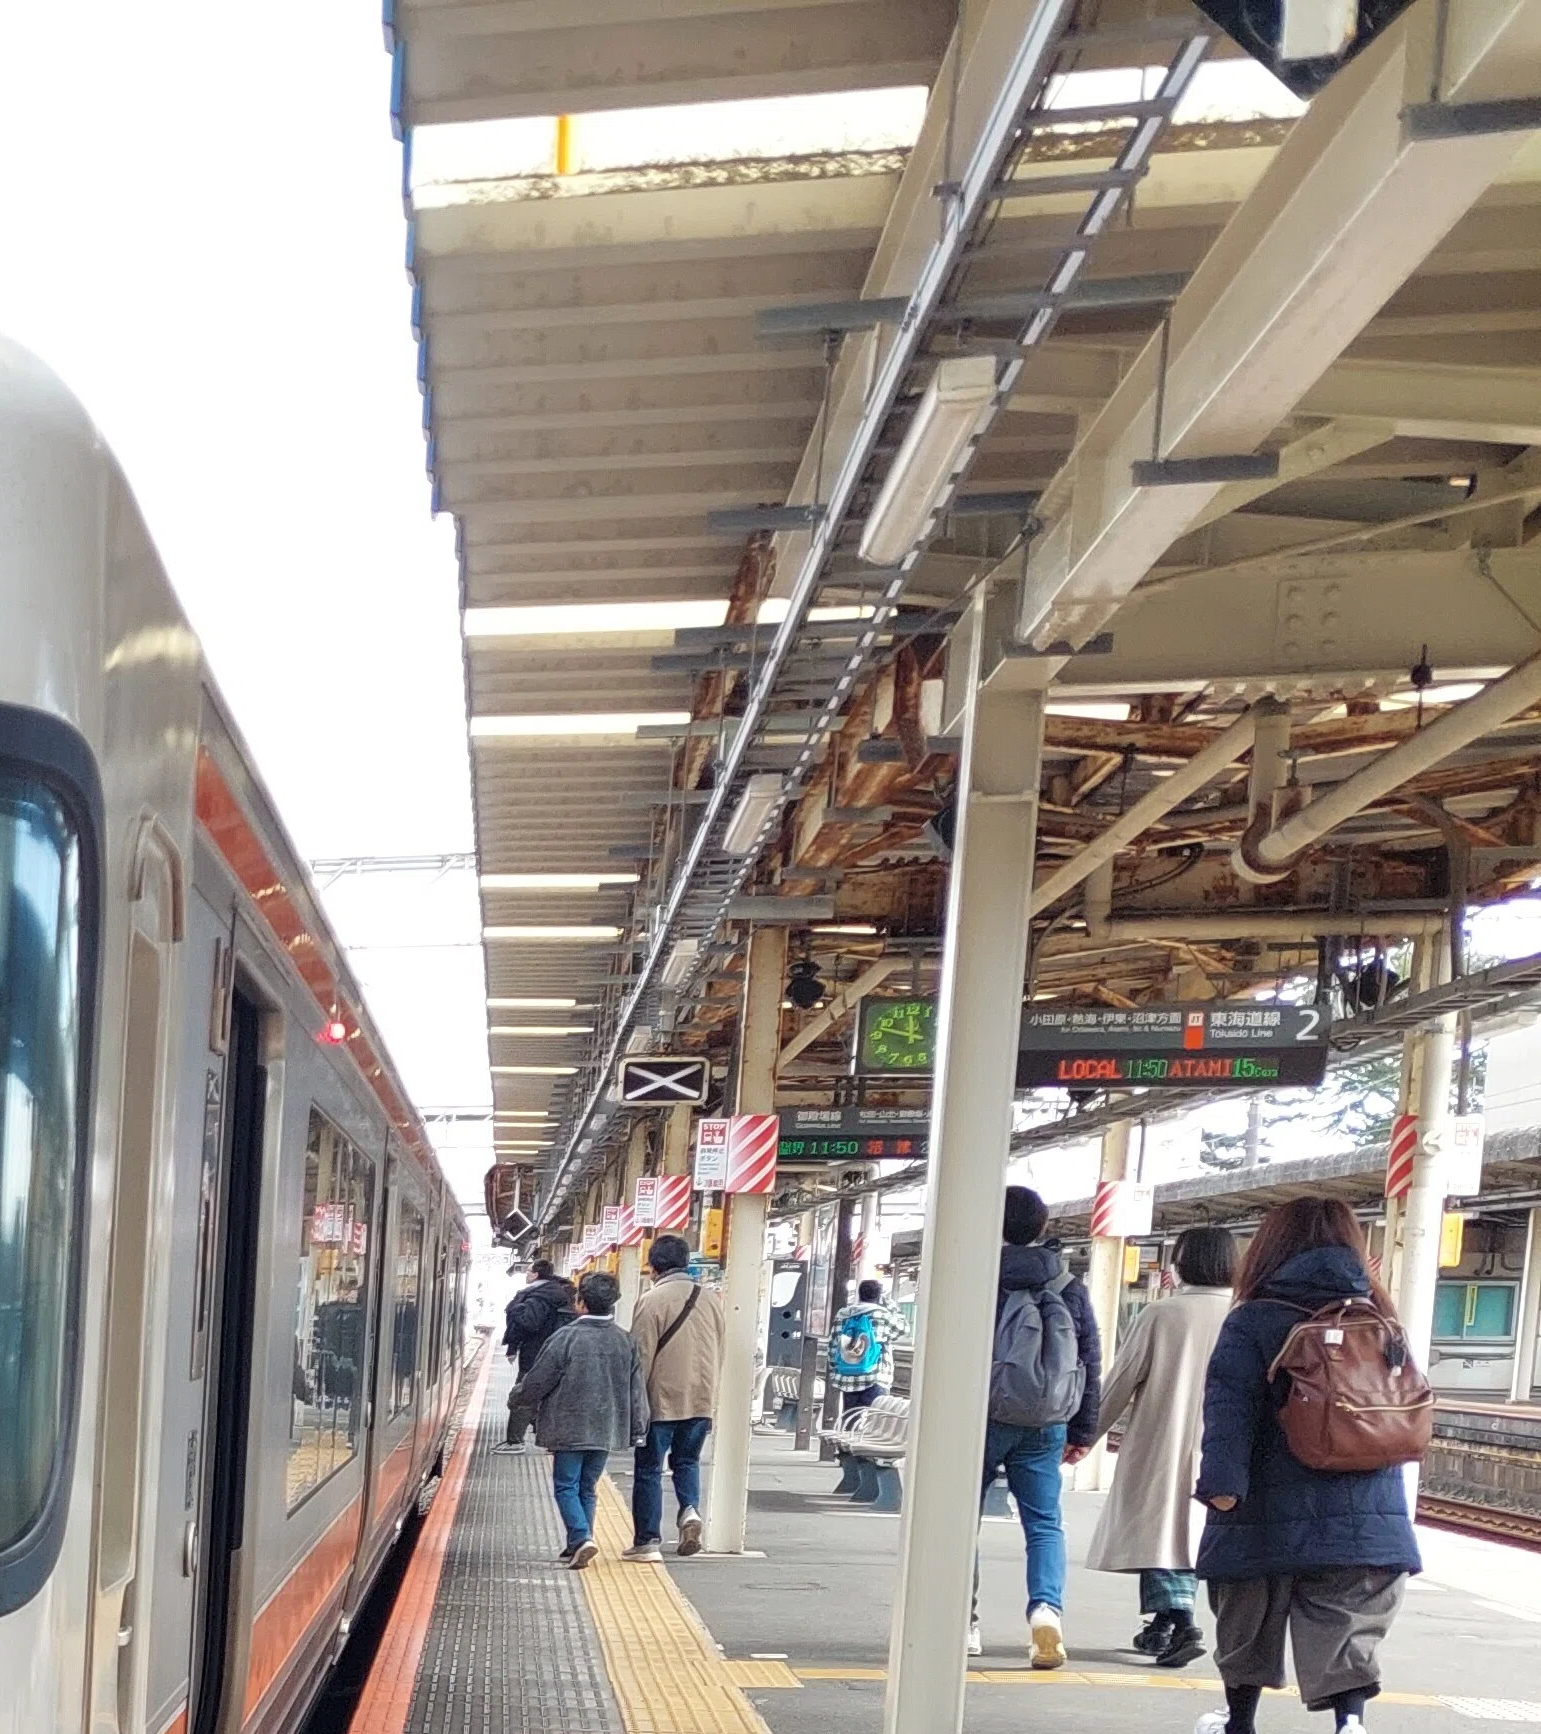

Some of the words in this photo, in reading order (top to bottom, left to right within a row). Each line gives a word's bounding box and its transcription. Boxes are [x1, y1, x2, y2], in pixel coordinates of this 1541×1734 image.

[1210, 1011, 1281, 1026] 東海道線
[1295, 1009, 1320, 1041] 2
[1210, 1028, 1248, 1038] Tokaido
[1251, 1029, 1273, 1038] Line
[1058, 1059, 1122, 1079] LOCAL
[1125, 1059, 1168, 1079] 11:50
[1169, 1059, 1232, 1077] ATAMI
[703, 1123, 726, 1131] STOP
[809, 1140, 859, 1155] 11:50
